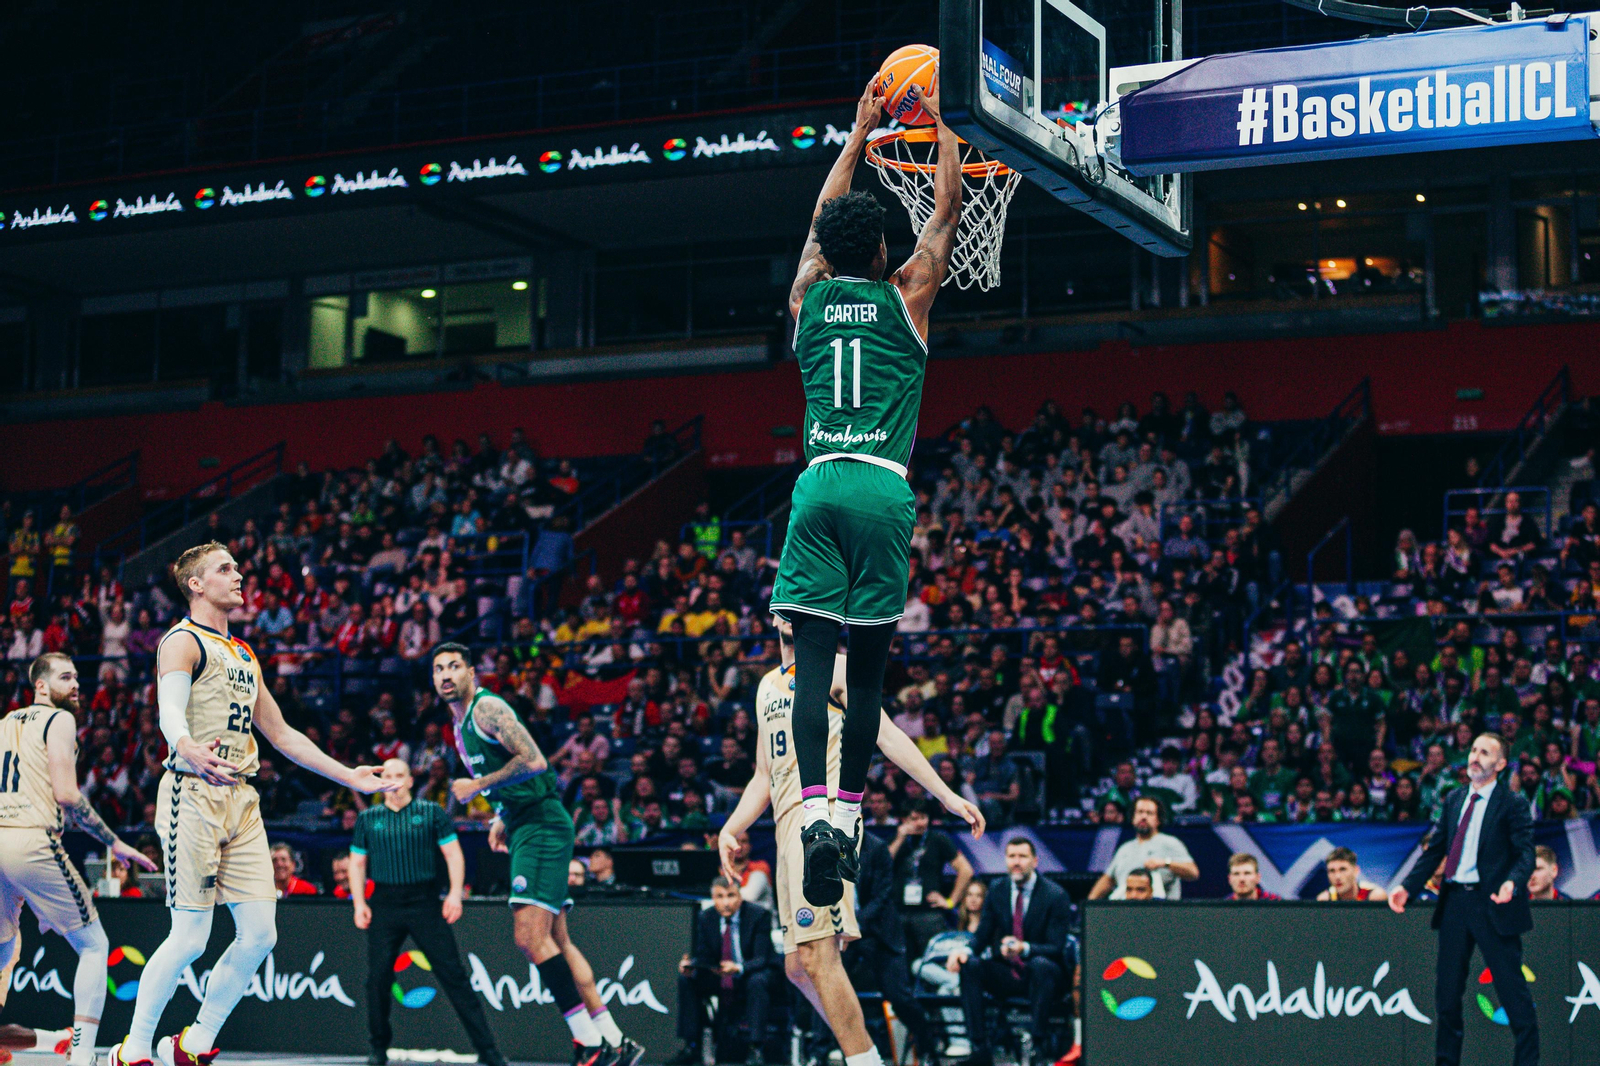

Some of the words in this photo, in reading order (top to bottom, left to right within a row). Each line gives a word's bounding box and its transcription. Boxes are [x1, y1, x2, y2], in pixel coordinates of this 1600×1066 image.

[1000, 64, 1021, 91] FOUR
[1237, 60, 1577, 147] #BasketballCL
[568, 143, 650, 169] Andalucía
[693, 130, 780, 158] Andalucía
[447, 155, 526, 182] Andalucía
[824, 304, 878, 323] CARTER
[830, 338, 861, 408] 11
[227, 702, 252, 735] 22
[763, 697, 792, 717] UCAM
[770, 729, 788, 760] 19
[1183, 958, 1432, 1025] Andalucía
